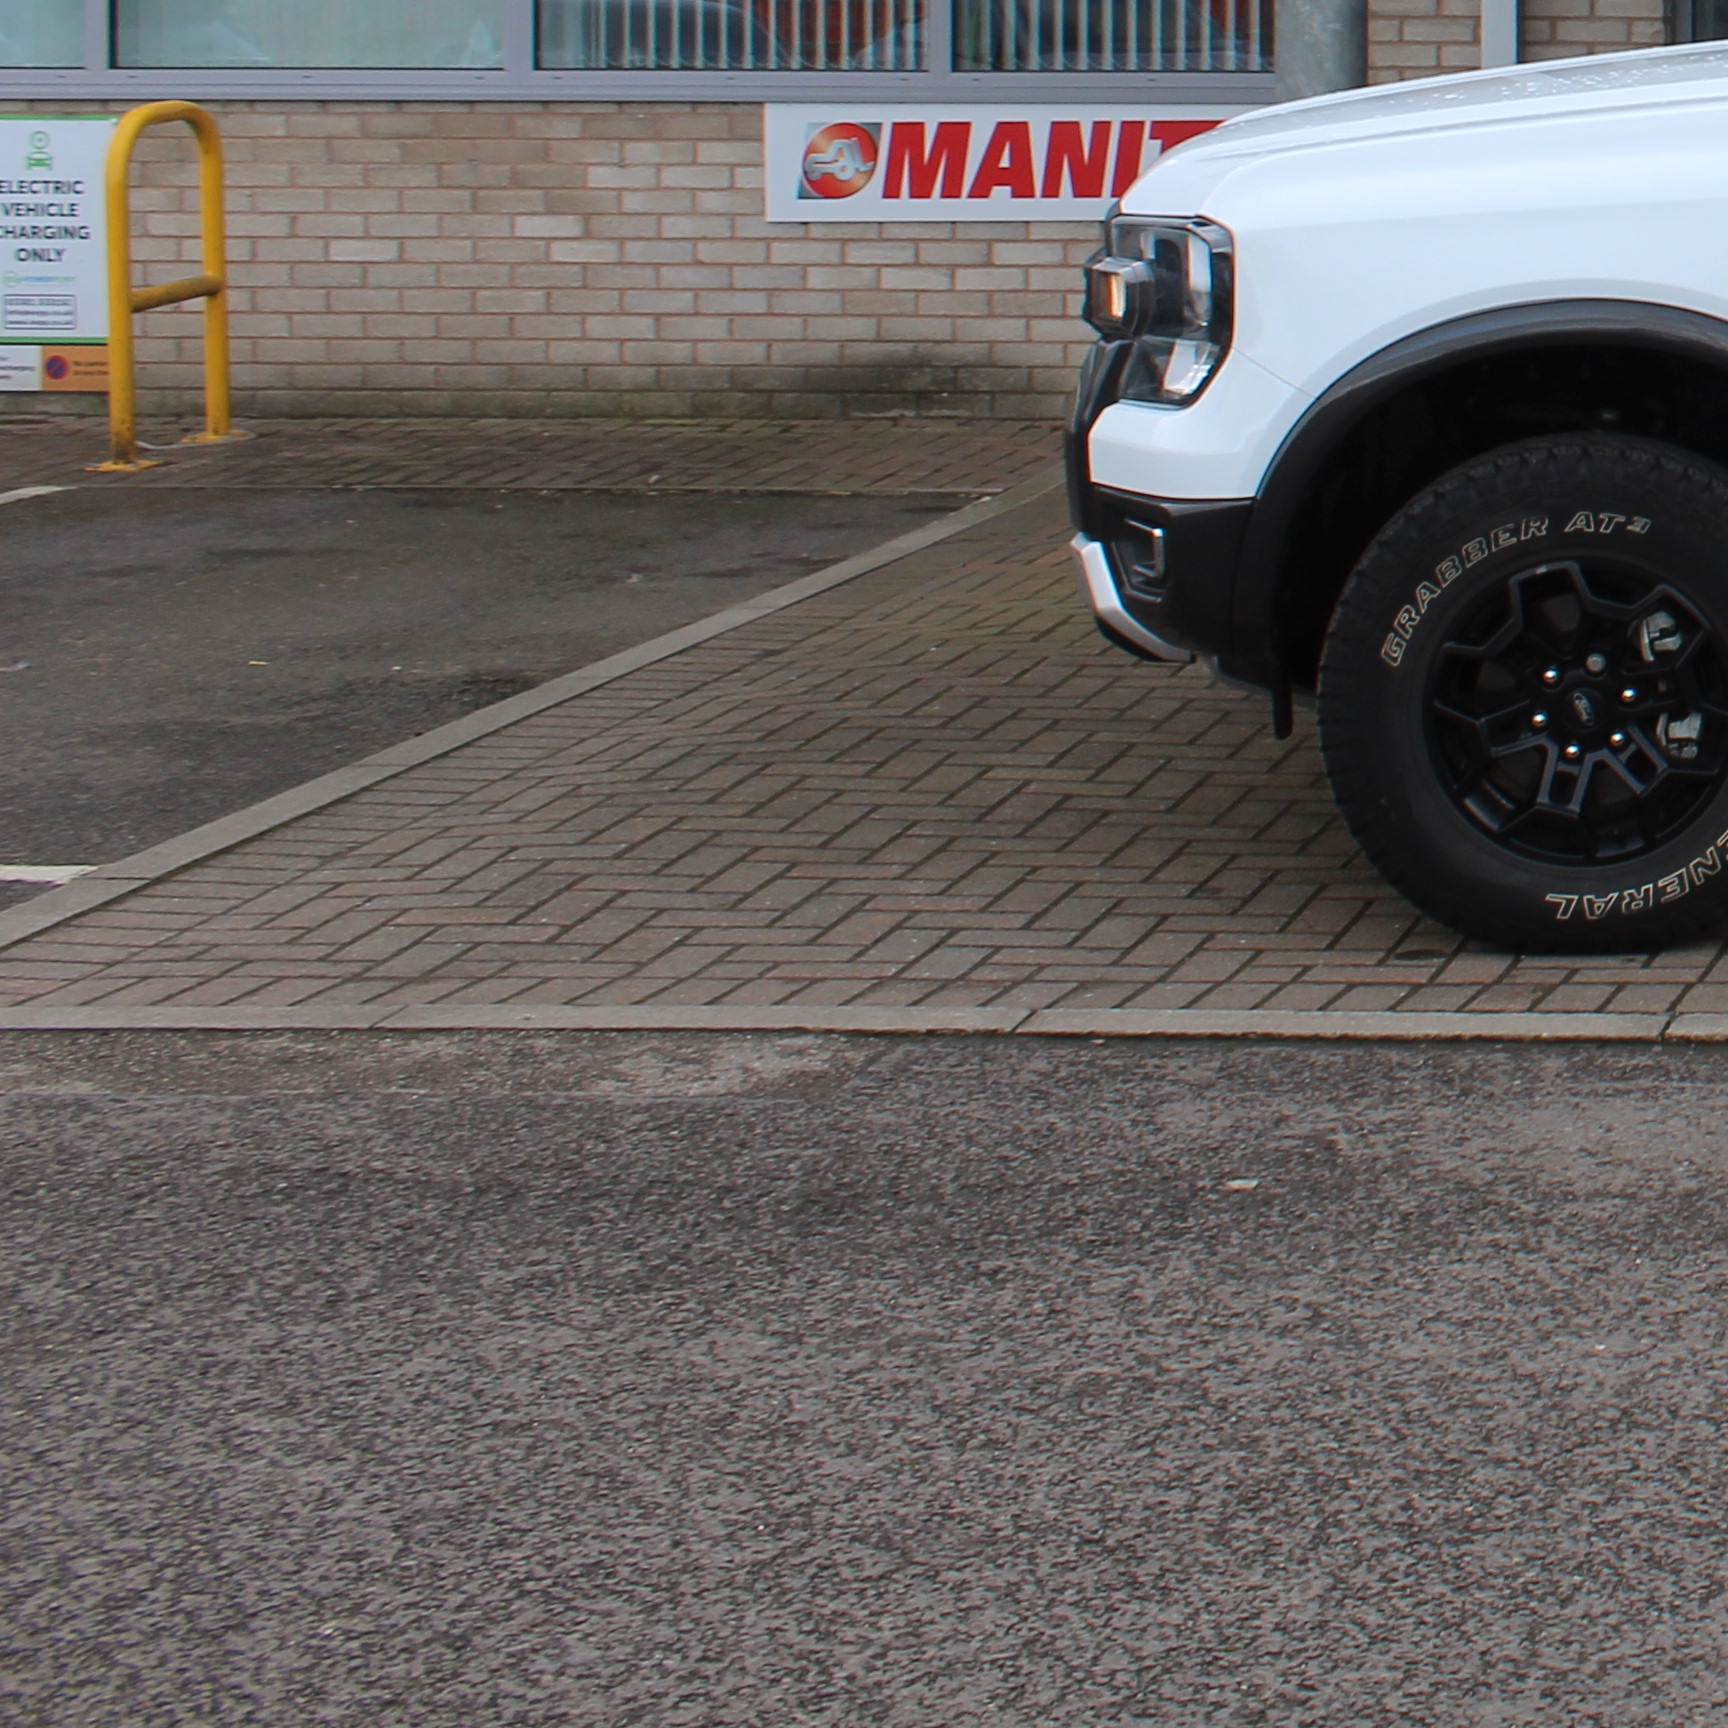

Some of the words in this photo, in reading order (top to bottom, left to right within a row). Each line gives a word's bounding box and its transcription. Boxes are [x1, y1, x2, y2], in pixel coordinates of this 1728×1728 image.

[1, 203, 80, 217] VEHICLE
[16, 248, 66, 262] ONLY
[1380, 515, 1549, 667] GRABBER
